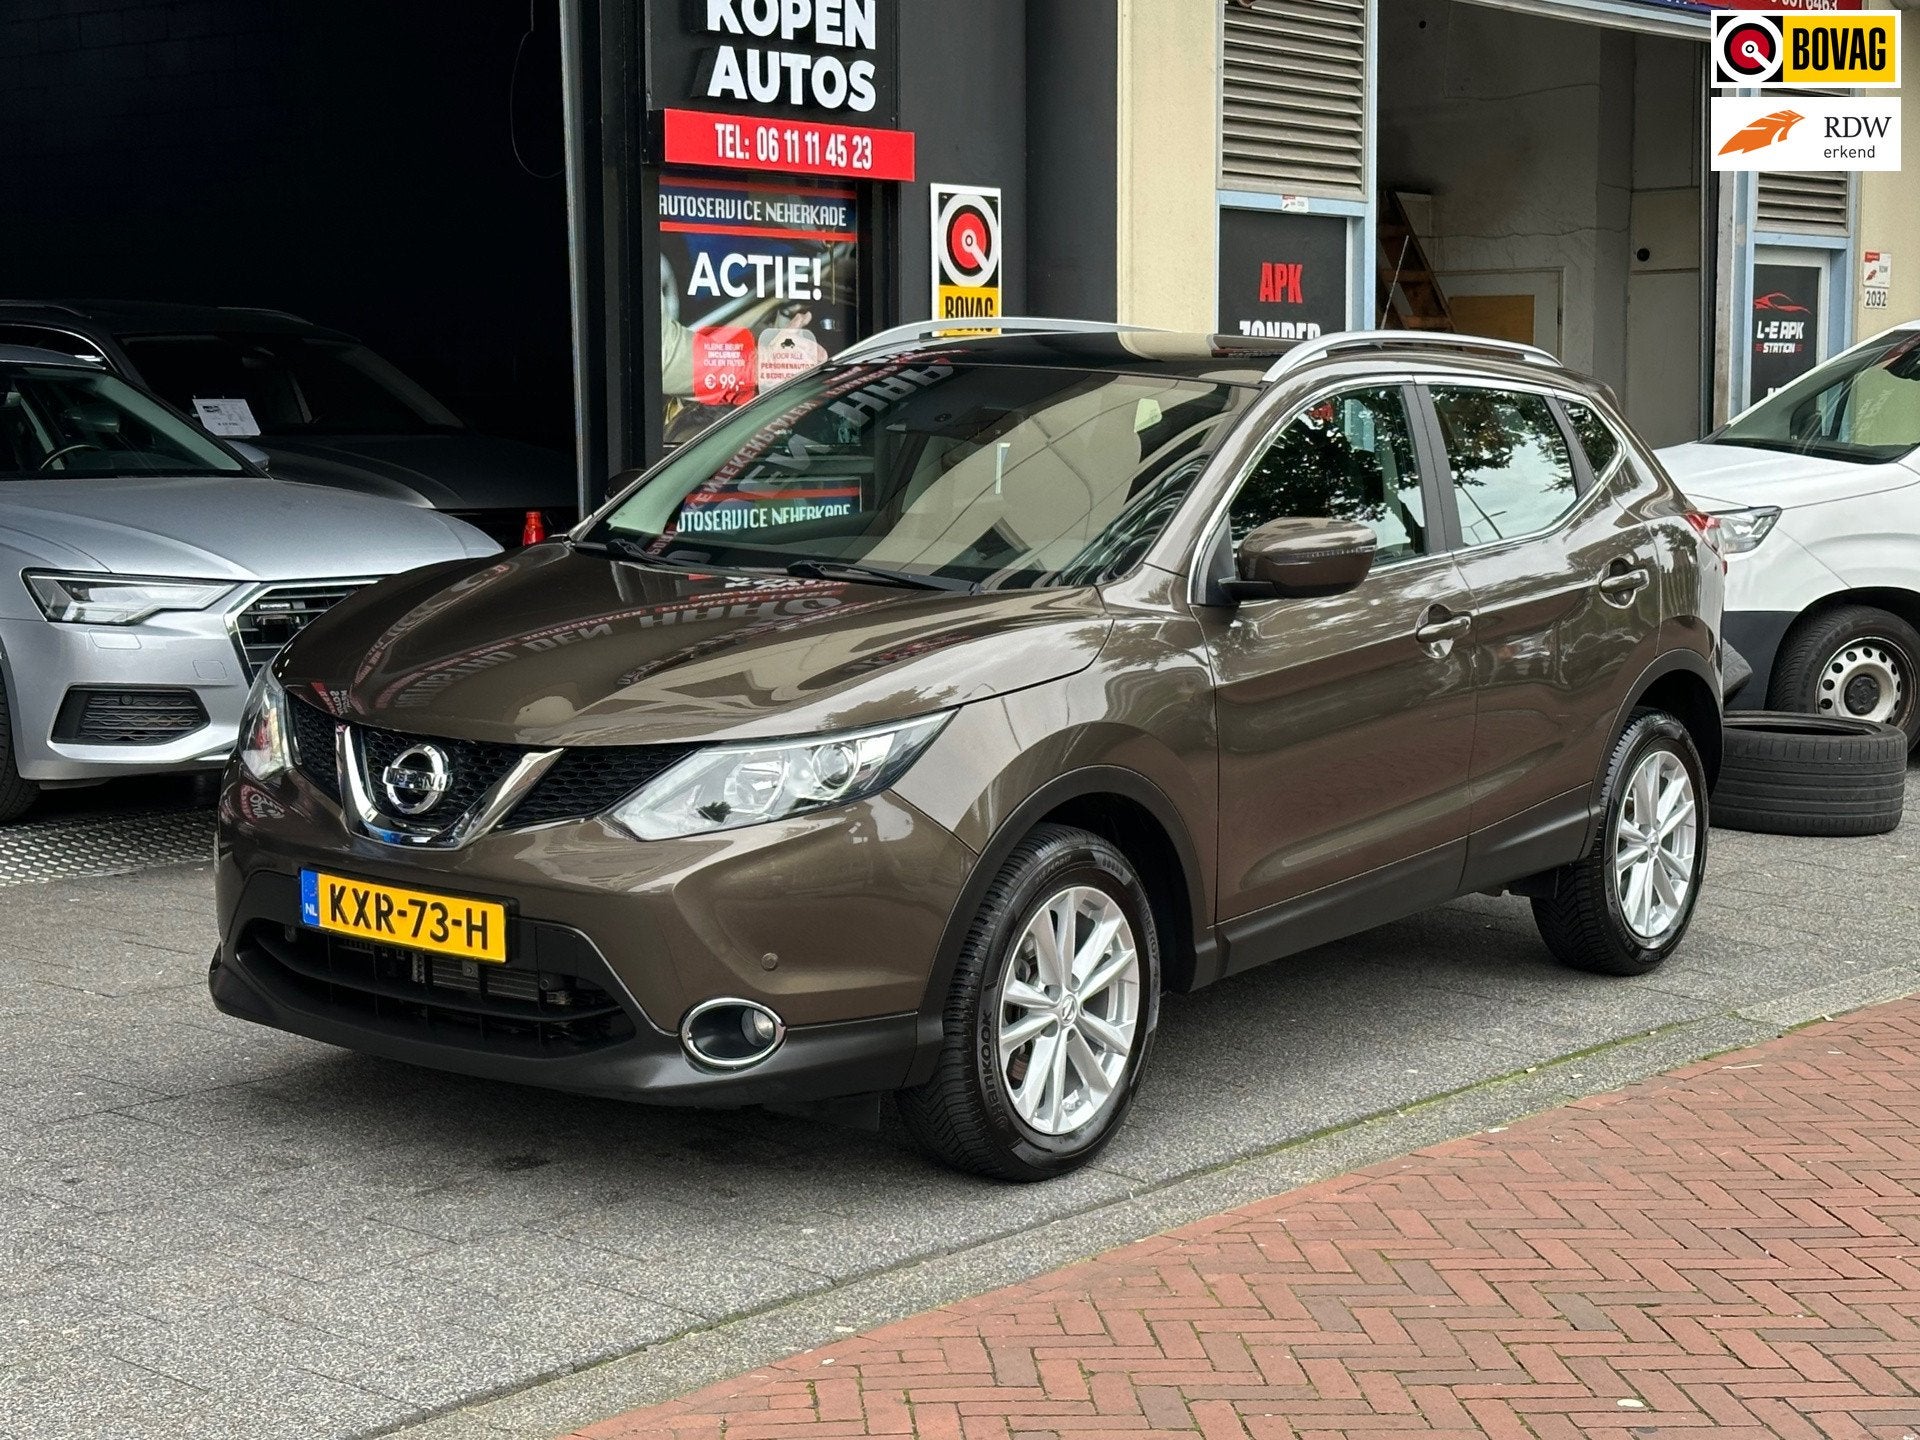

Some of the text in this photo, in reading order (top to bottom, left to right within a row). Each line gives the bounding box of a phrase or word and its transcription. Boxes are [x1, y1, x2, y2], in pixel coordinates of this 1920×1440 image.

[706, 0, 876, 50] KOPEN
[707, 46, 877, 112] AUTOS
[715, 123, 872, 170] TEL: 06 11 11 45 23
[659, 194, 847, 227] AUTOSERVICE NEHERKADE
[687, 252, 823, 301] ACTIE!
[1259, 262, 1303, 304] APK
[1866, 291, 1886, 307] 2032
[1757, 320, 1804, 339] L-E APK
[1762, 342, 1796, 354] STATION
[704, 373, 745, 391] € 99,-
[675, 508, 768, 533] UTOSERVICE
[305, 903, 318, 916] NL
[329, 883, 488, 950] KXR-73-H
